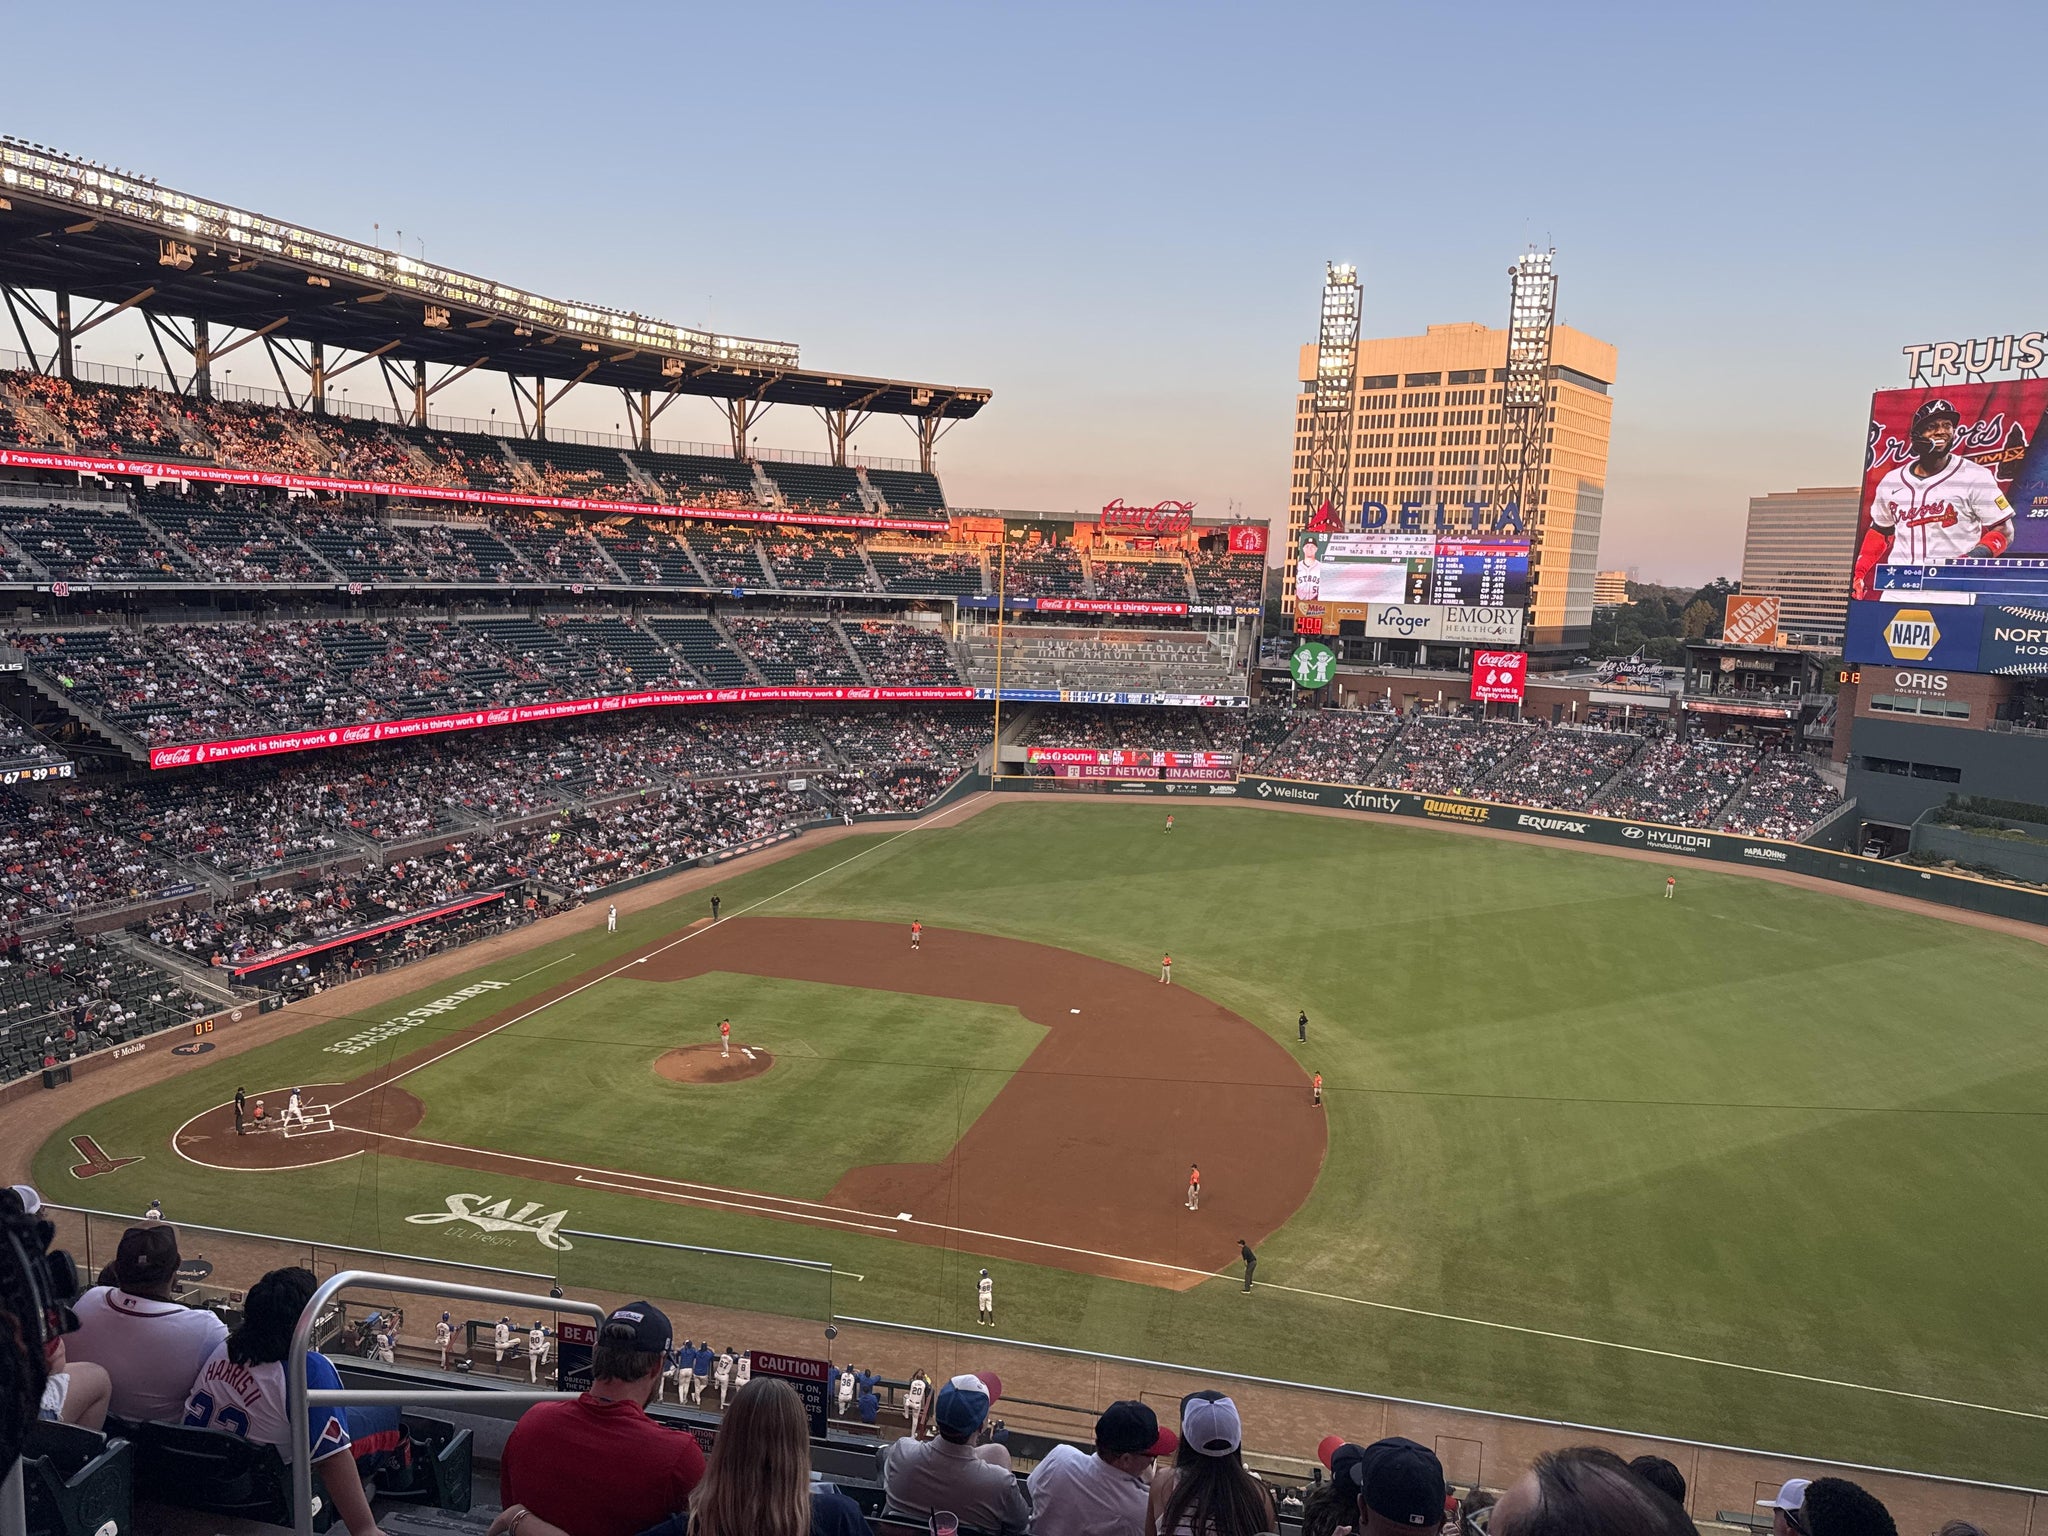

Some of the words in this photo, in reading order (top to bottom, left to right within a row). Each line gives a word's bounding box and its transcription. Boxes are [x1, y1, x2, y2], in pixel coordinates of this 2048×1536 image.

[12, 455, 29, 464] Fan
[30, 458, 51, 466] work
[64, 460, 93, 470] thirsty
[208, 471, 232, 480] thirsty
[1361, 502, 1524, 534] DELTA
[1929, 568, 1937, 577] 0
[52, 582, 70, 596] 41
[348, 582, 362, 594] 44
[1122, 604, 1149, 612] thirsty
[1447, 607, 1519, 624] EMORY
[1731, 602, 1754, 619] THE
[1298, 618, 1322, 629] 400
[1378, 606, 1430, 635] Kroger
[1724, 597, 1780, 643] HOME
[1447, 625, 1514, 634] HEALTHCARE
[1744, 616, 1778, 643] DEPOT
[1893, 624, 1930, 645] NAPA
[1478, 653, 1523, 668] Coca-Cola
[1597, 660, 1614, 674] All
[1617, 662, 1637, 673] Star
[1637, 663, 1664, 676] Game
[1736, 660, 1774, 670] CLUBHOUSE
[1895, 672, 1948, 690] ORIS
[661, 694, 685, 704] thirsty
[788, 689, 813, 698] thirsty
[520, 710, 532, 719] Fan
[533, 708, 549, 716] work
[556, 705, 576, 715] thirsty
[577, 703, 592, 711] work
[384, 725, 399, 735] Fan
[400, 723, 420, 733] work
[422, 722, 429, 730] is
[430, 719, 454, 730] thirsty
[456, 717, 474, 726] work
[343, 728, 370, 741] Coca-Cola
[210, 747, 228, 757] Fan
[231, 745, 256, 755] work
[259, 742, 266, 751] is
[269, 738, 301, 751] thirsty
[303, 734, 326, 745] work
[155, 749, 191, 766] Coca-Cola
[4, 772, 20, 784] 67
[21, 770, 31, 778] RBI
[32, 768, 47, 780] 39
[49, 767, 57, 775] HR
[59, 765, 71, 777] 13
[1086, 767, 1112, 775] BEST
[1182, 769, 1231, 778] AMERICA
[1274, 786, 1319, 800] Wellstar
[1343, 791, 1400, 812] xfinity
[1424, 799, 1488, 818] QUIKRETE
[1517, 814, 1587, 834] EQUIFAX
[1647, 840, 1696, 852] HyundaiUSA.com
[1648, 830, 1711, 848] HYUNDAI
[1744, 848, 1761, 856] PAPA
[1761, 849, 1786, 860] JOHNS
[172, 886, 194, 894] HYUNDAI
[322, 1017, 409, 1052] CASINOS
[339, 1018, 425, 1055] CHEROKEE
[121, 1043, 146, 1057] Mobile
[405, 1193, 573, 1250] SAIA
[444, 1227, 465, 1238] LTL
[470, 1231, 519, 1248] Freight
[564, 1327, 582, 1340] BE
[759, 1356, 819, 1376] CAUTION
[207, 1360, 254, 1395] HARRIS
[564, 1376, 591, 1385] OBJECTS
[790, 1383, 803, 1391] SIT
[806, 1385, 821, 1394] ON,
[807, 1395, 819, 1403] OR
